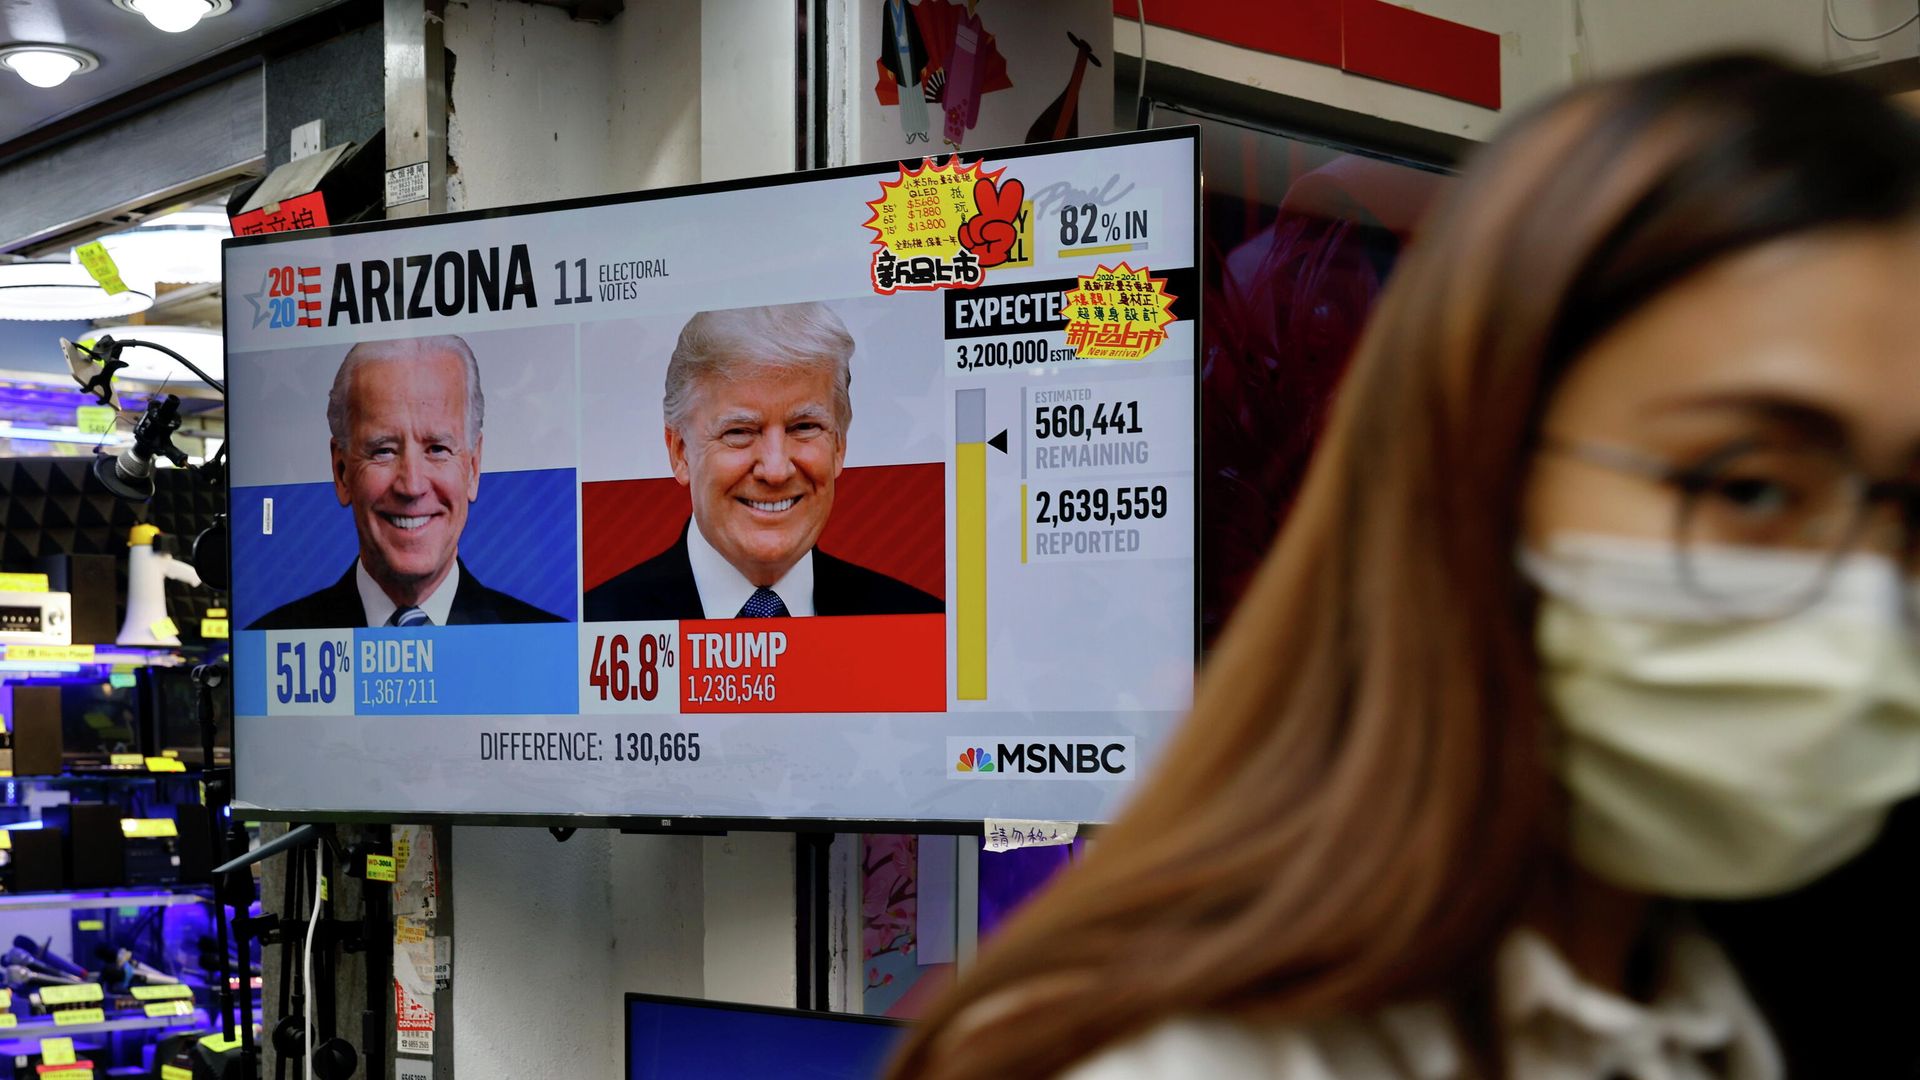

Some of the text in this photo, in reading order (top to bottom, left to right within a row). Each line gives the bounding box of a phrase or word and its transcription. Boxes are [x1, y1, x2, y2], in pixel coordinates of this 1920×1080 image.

[909, 187, 938, 198] QLED
[1125, 209, 1148, 240] IN
[268, 266, 294, 298] 20
[599, 259, 669, 283] ELECTORAL
[877, 249, 980, 288] 新品上市
[328, 244, 593, 328] ARIZONA 11
[599, 280, 638, 302] VOTES
[269, 298, 295, 329] 20
[1066, 320, 1164, 355] 新品上市
[1088, 347, 1141, 358] New arrival
[957, 338, 1049, 371] 3,200,000
[1035, 388, 1092, 404] ESTIMATED
[1035, 400, 1143, 442] 560,441
[1035, 441, 1149, 470] REMAINING
[1035, 485, 1168, 529] 2,639,559
[1035, 529, 1141, 556] REPORTED
[276, 639, 435, 704] 51.8% BIDEN
[589, 631, 787, 702] 46.8% TRUMP
[361, 679, 438, 707] 1,367,211
[687, 674, 776, 705] 1,236,546
[480, 732, 701, 766] DIFFERENCE: 130,665
[997, 743, 1127, 774] MSNBC
